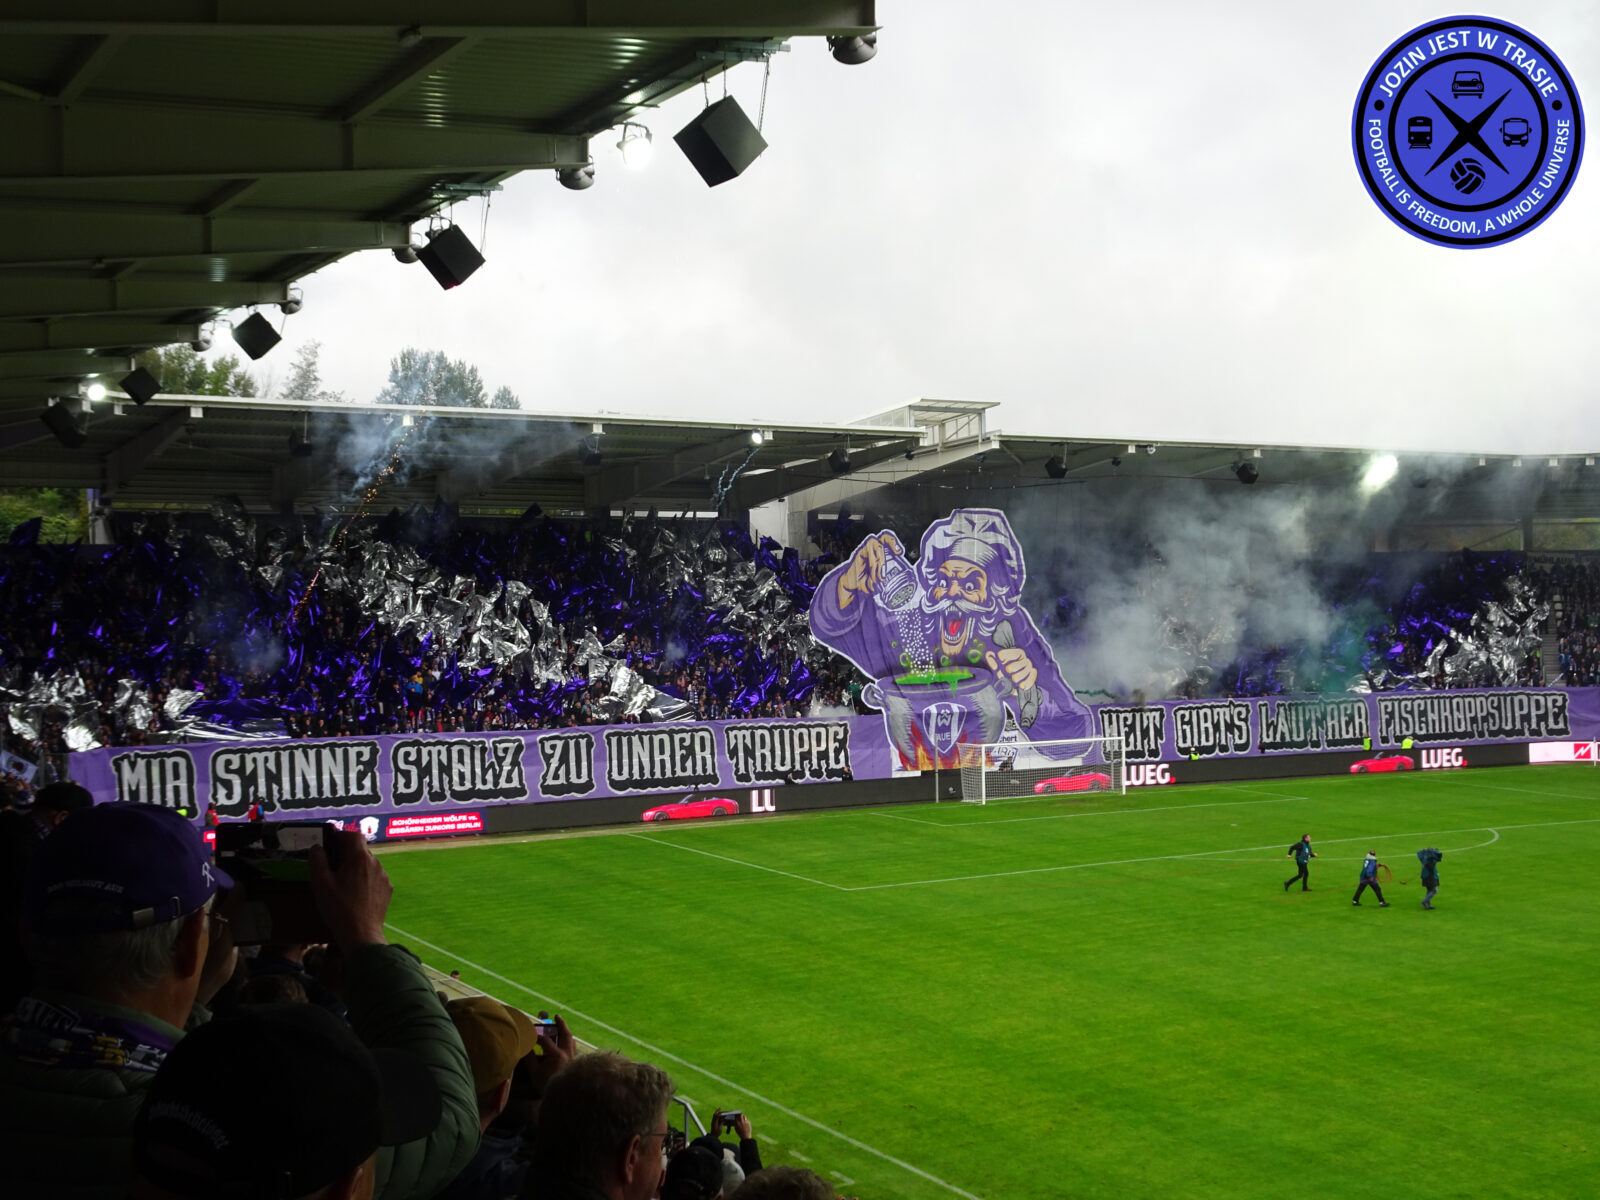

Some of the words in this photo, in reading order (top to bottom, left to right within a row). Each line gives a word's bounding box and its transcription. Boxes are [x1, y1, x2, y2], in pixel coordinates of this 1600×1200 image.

[1101, 709, 1163, 755] HEIT
[1175, 703, 1249, 750] GIBT'S
[212, 744, 376, 807] STINNE
[541, 735, 593, 788] ZU
[726, 723, 847, 778] TRUPPE
[425, 823, 455, 832] JUNIORS
[457, 821, 481, 829] BERLIN
